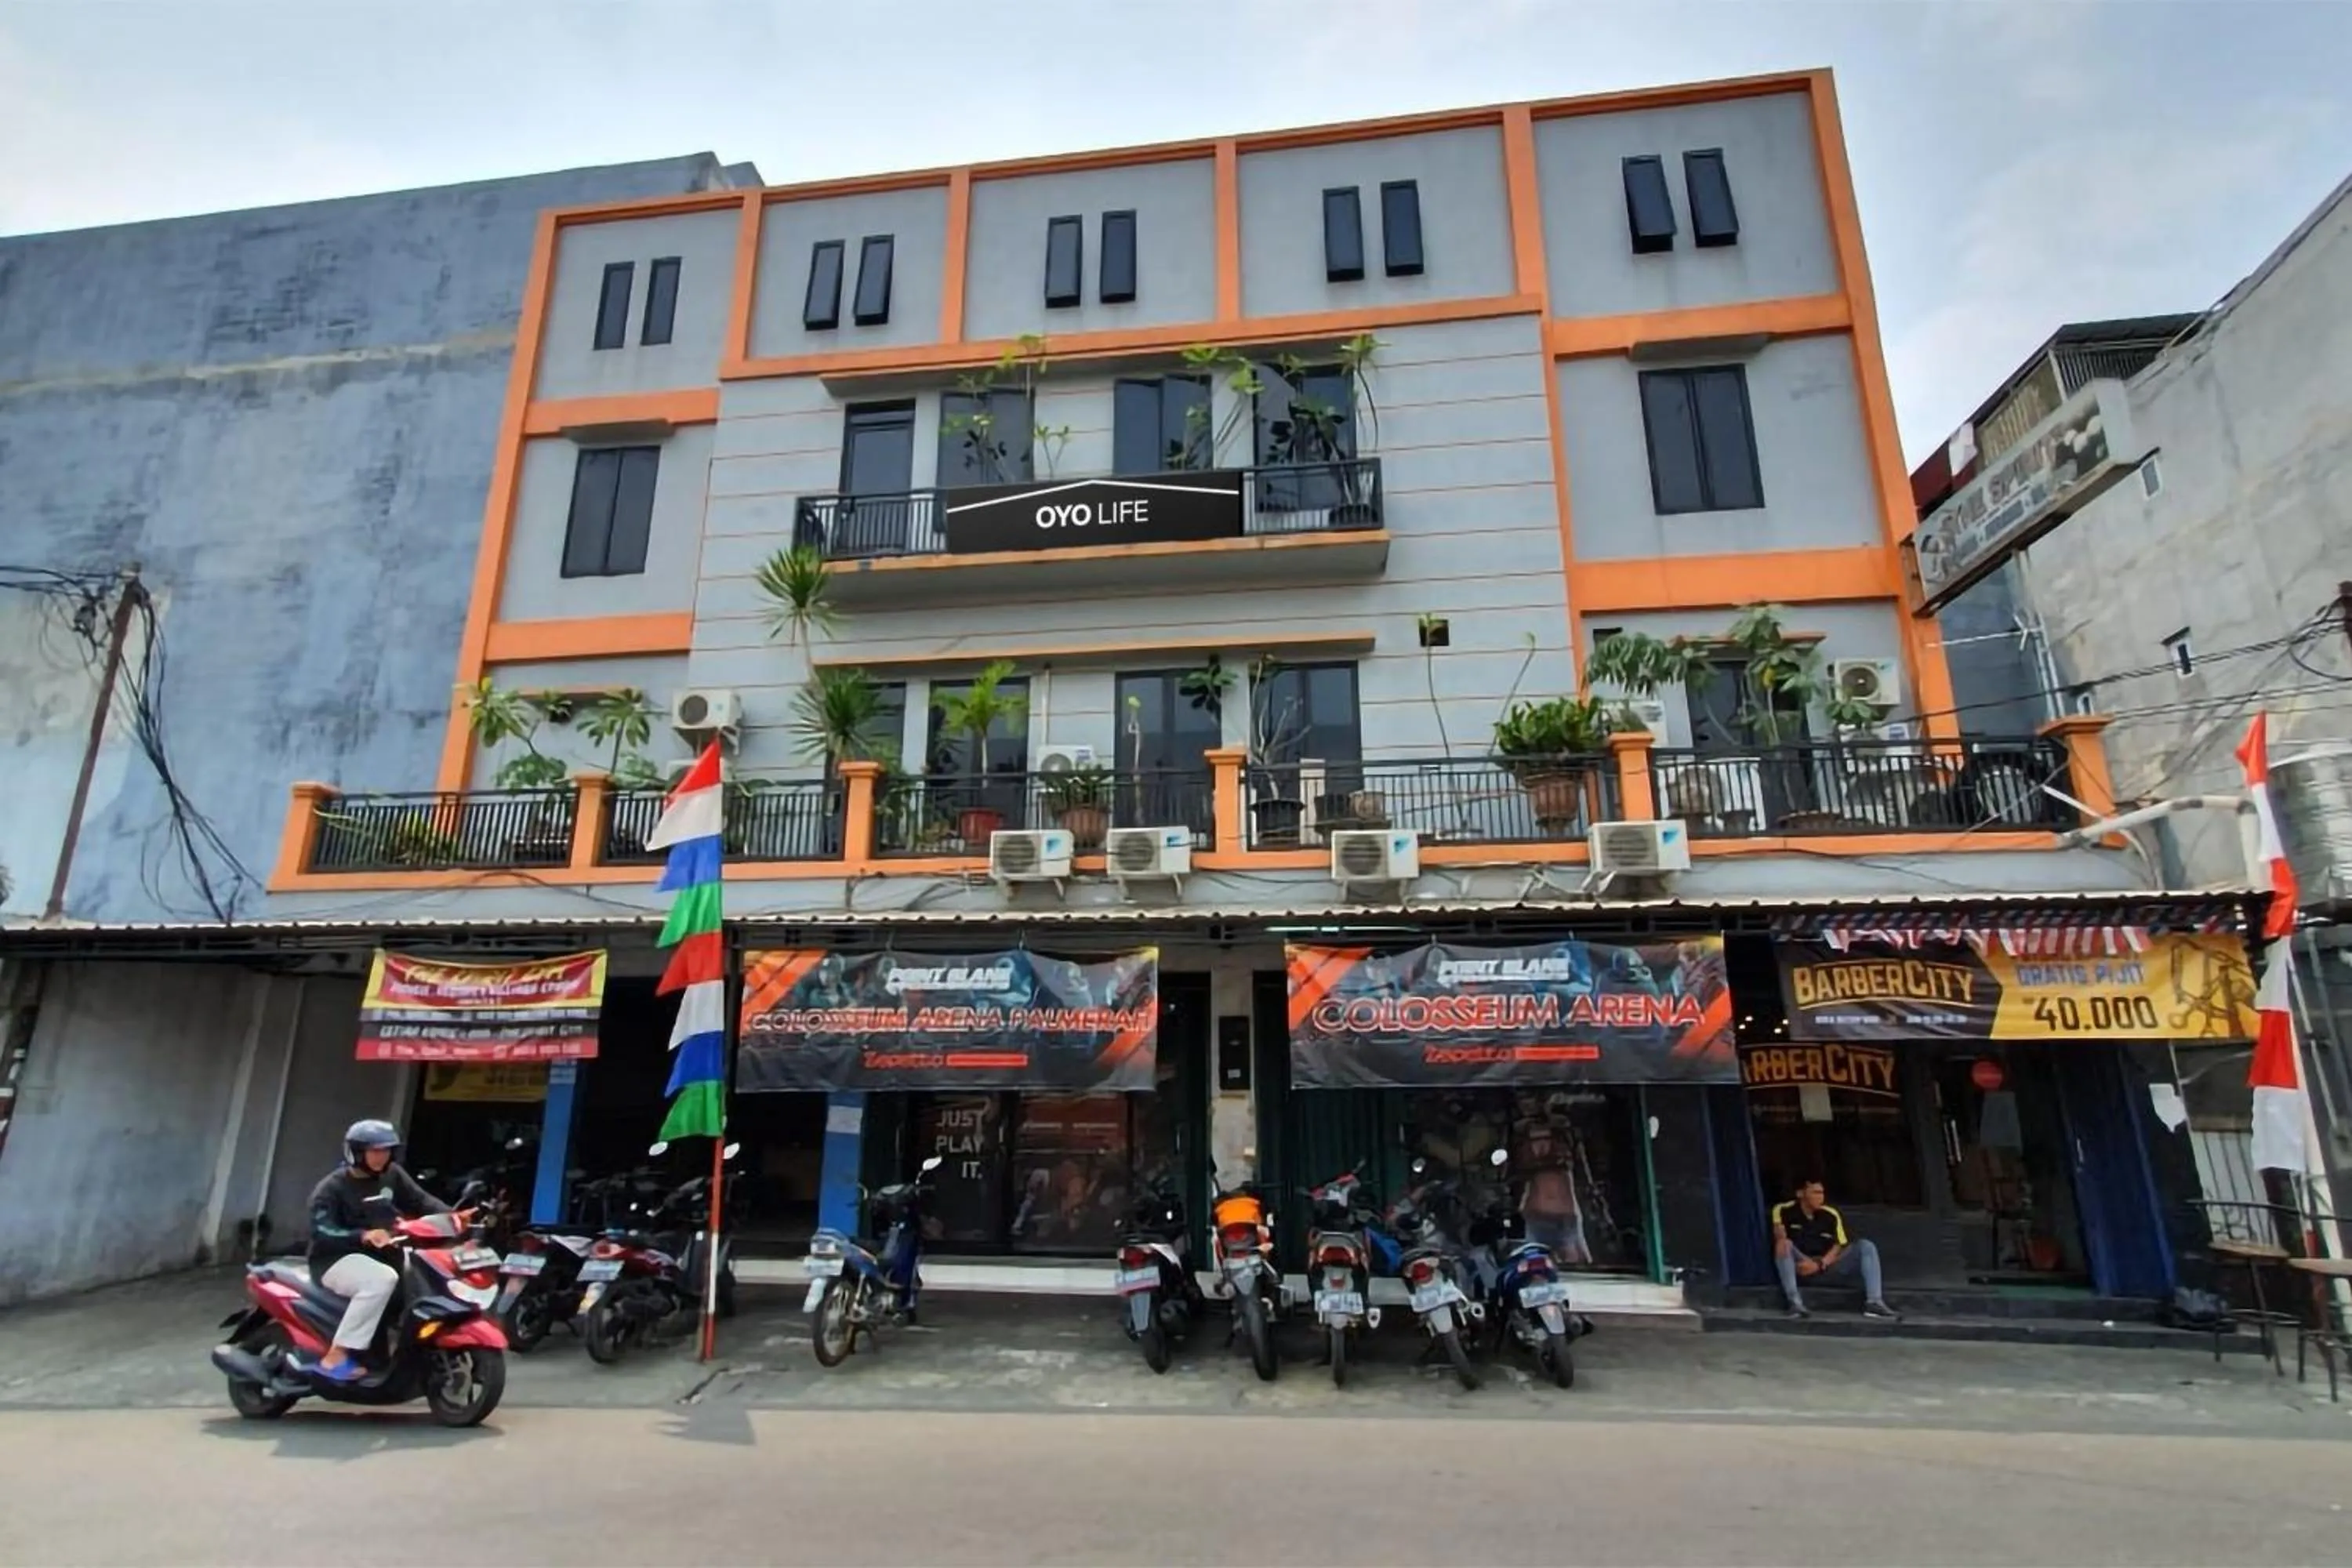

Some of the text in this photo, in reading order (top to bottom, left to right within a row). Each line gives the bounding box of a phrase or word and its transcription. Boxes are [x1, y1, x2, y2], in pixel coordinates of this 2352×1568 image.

[1036, 500, 1149, 528] OYO LIFE
[910, 1006, 1004, 1033] ARENA
[1312, 993, 1704, 1033] COLOSSEUM ARENA
[2034, 996, 2158, 1031] 40.000
[935, 1110, 984, 1127] JUST
[935, 1135, 984, 1153] PLAY
[962, 1161, 984, 1178] IT.
